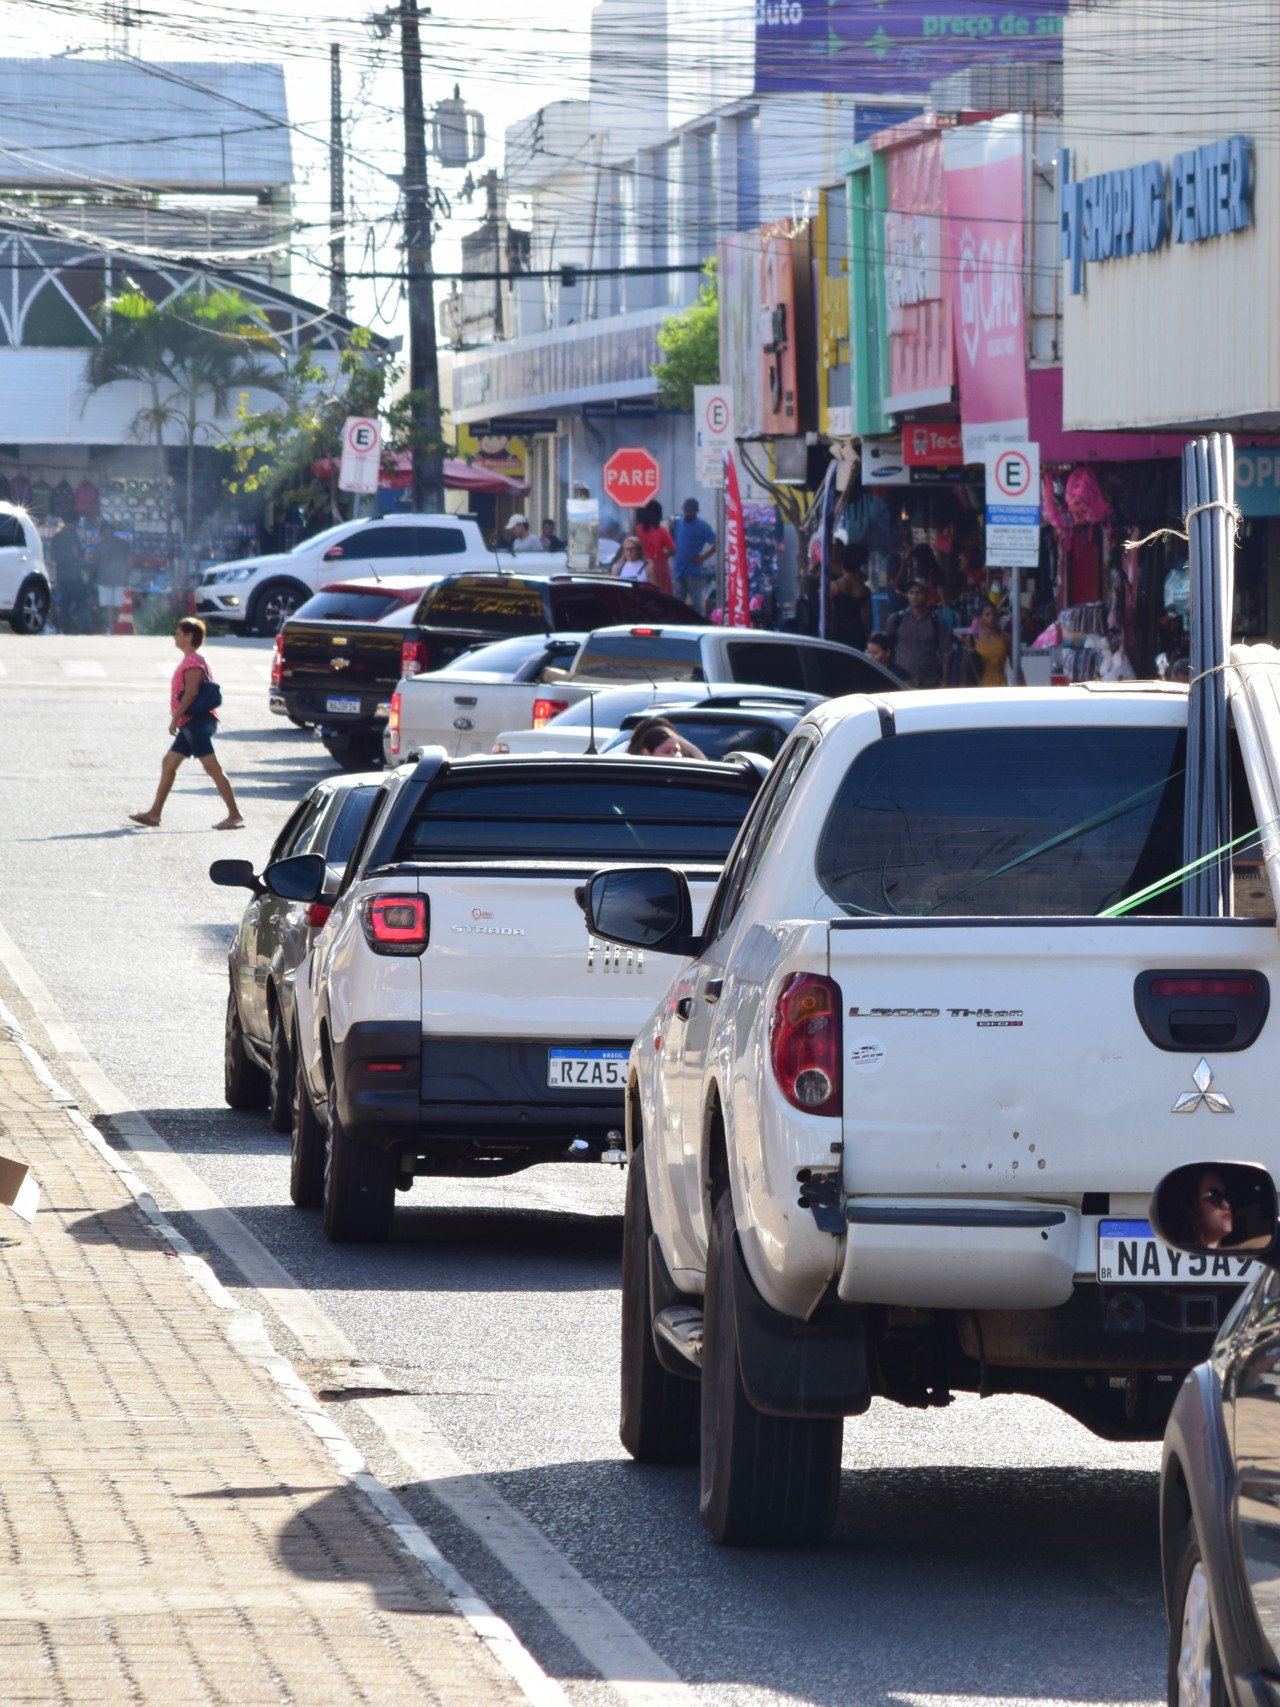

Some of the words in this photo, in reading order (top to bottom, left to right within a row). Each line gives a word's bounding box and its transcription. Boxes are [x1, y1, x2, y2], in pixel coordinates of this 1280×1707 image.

[923, 16, 993, 37] preço
[1000, 12, 1029, 35] de
[1082, 160, 1166, 263] SHOPPING
[1172, 135, 1250, 244] CENTER
[713, 405, 723, 425] E
[356, 429, 369, 446] E
[930, 432, 962, 449] Tec
[607, 469, 656, 487] PARE
[1006, 462, 1021, 486] E
[452, 925, 526, 936] STRADA
[849, 1007, 940, 1017] L200
[947, 1008, 1024, 1017] Triton
[1101, 1268, 1112, 1279] BR
